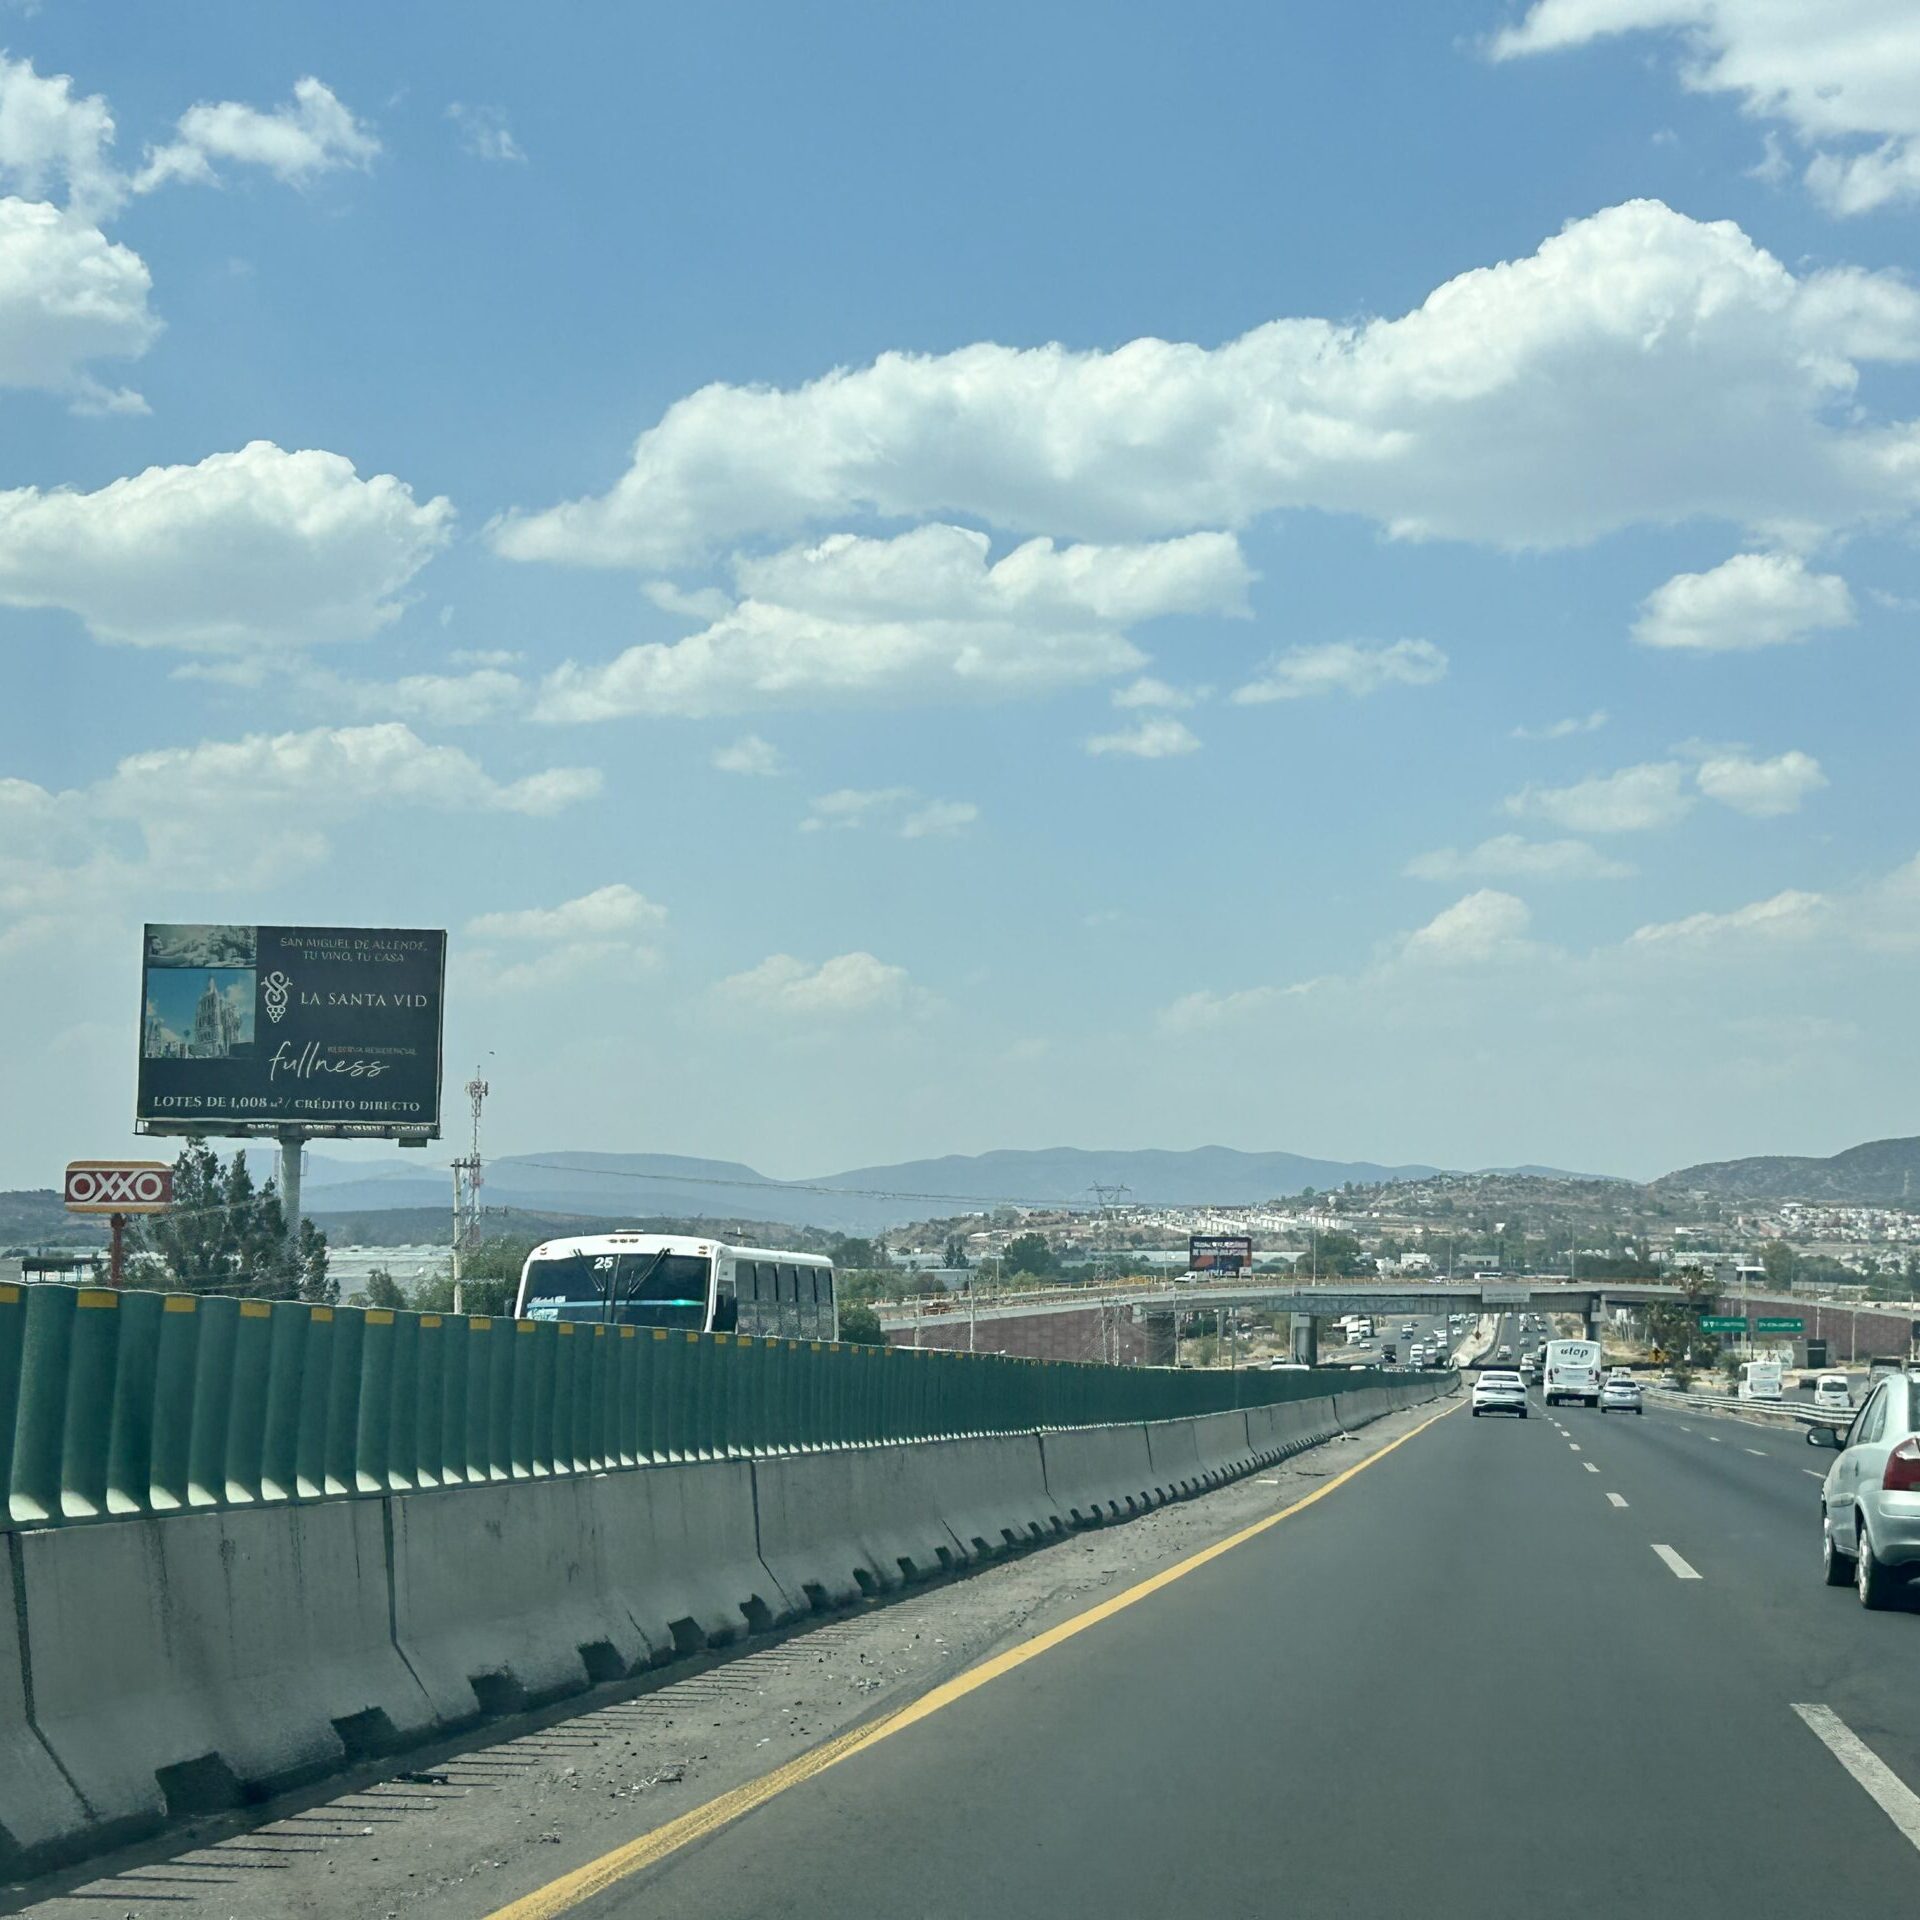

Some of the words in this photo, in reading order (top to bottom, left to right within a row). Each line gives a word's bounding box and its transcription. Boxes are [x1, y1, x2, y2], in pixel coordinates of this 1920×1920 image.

[280, 937, 302, 947] SAN
[306, 938, 349, 949] MIGUEL
[354, 939, 369, 950] DE
[303, 950, 318, 960] TU
[321, 951, 353, 962] VINO,
[357, 952, 371, 962] TU
[374, 953, 404, 963] CASA
[301, 991, 321, 1006] LA
[328, 992, 386, 1007] SANTA
[394, 994, 428, 1008] VID
[268, 1040, 390, 1081] fullness
[153, 1096, 202, 1108] LOTES
[206, 1096, 227, 1108] DE
[230, 1097, 267, 1109] 1,008
[295, 1098, 355, 1110] CRÉDITO
[359, 1100, 420, 1112] DIRECTO
[69, 1168, 163, 1204] OXXO
[594, 1256, 614, 1270] 25
